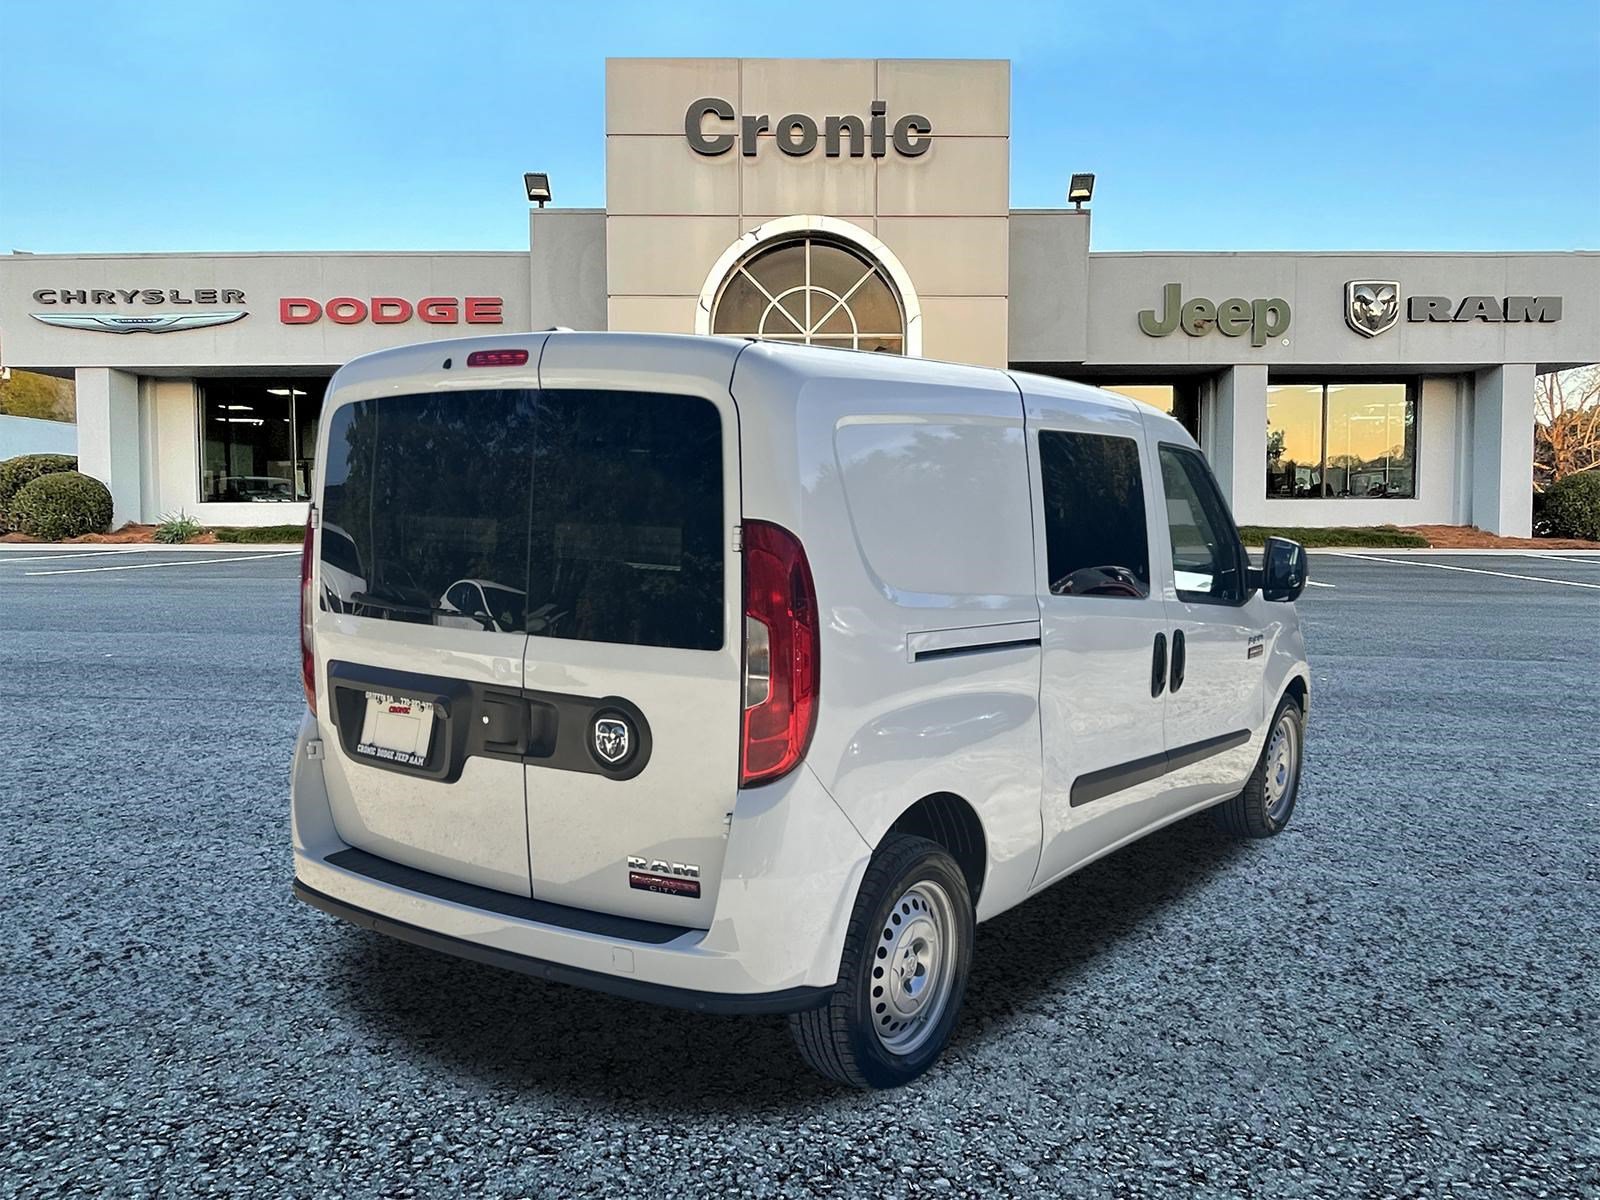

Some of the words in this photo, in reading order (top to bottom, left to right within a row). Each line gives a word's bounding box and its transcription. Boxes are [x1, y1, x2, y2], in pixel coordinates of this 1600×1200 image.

[684, 97, 932, 158] Cronic
[32, 288, 248, 305] CHRYSLER
[1407, 296, 1563, 323] RAM
[280, 297, 504, 325] DODGE
[1137, 283, 1292, 348] Jeep
[627, 855, 699, 877] RAM
[649, 885, 677, 894] CITY
